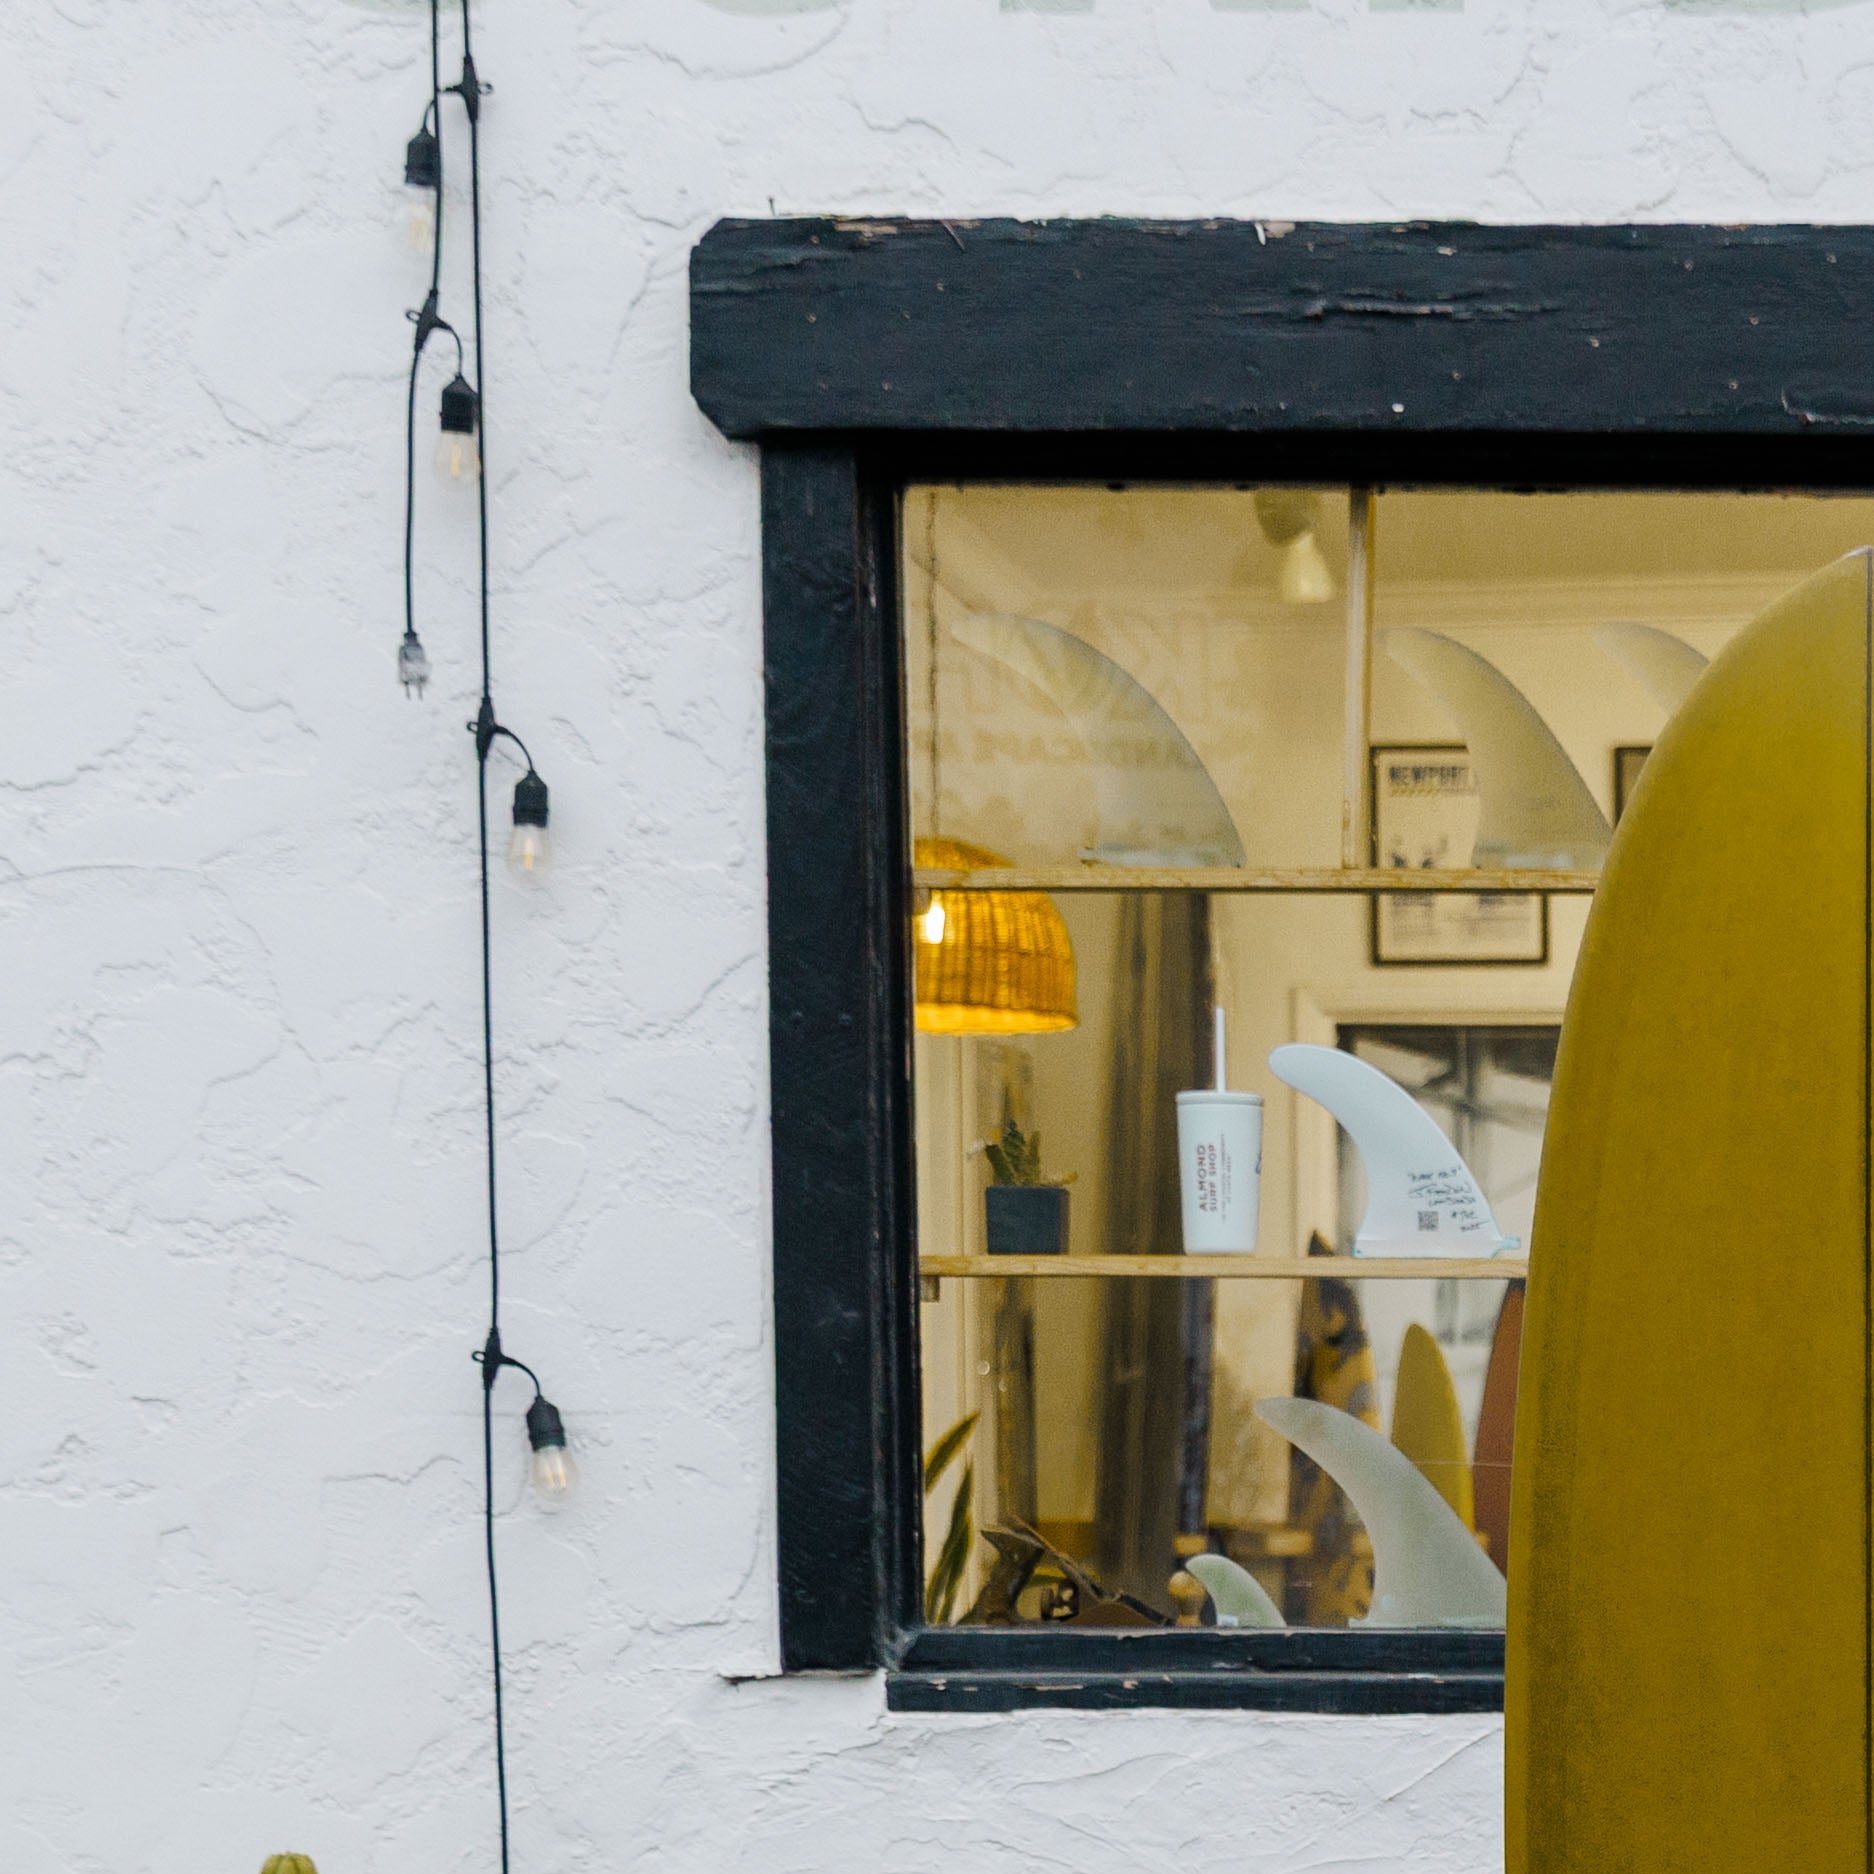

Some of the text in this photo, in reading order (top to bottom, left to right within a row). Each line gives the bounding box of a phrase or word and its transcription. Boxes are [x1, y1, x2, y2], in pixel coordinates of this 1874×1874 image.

[1197, 1144, 1207, 1212] ALMOND
[1208, 1144, 1217, 1212] SURF SHOP
